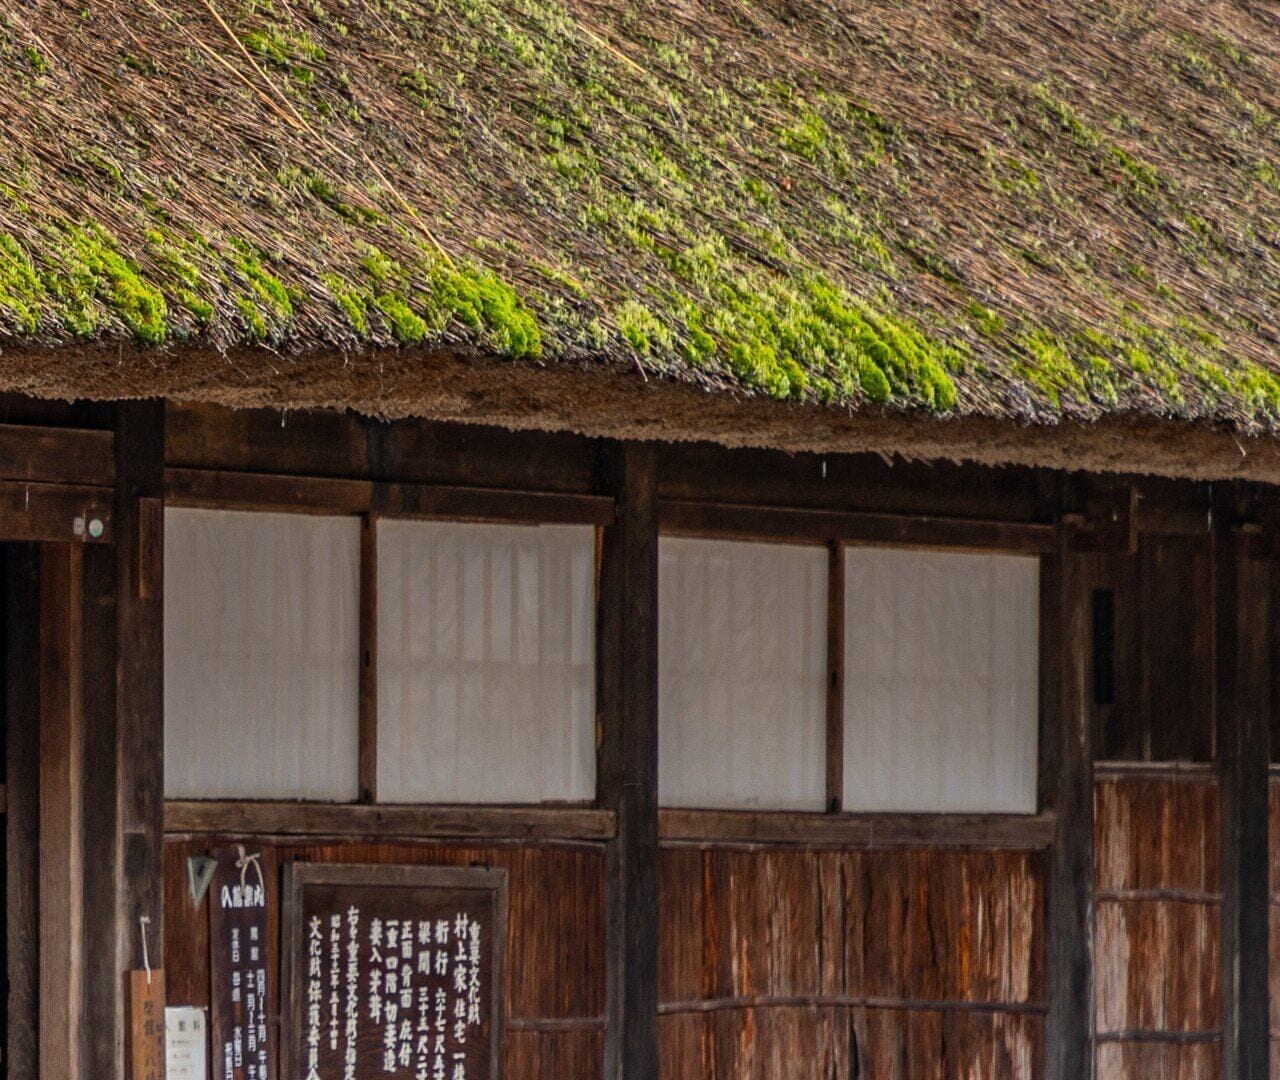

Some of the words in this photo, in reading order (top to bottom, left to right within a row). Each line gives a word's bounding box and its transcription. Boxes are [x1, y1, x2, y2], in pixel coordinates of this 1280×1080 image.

[468, 920, 481, 1025] 重要文化財
